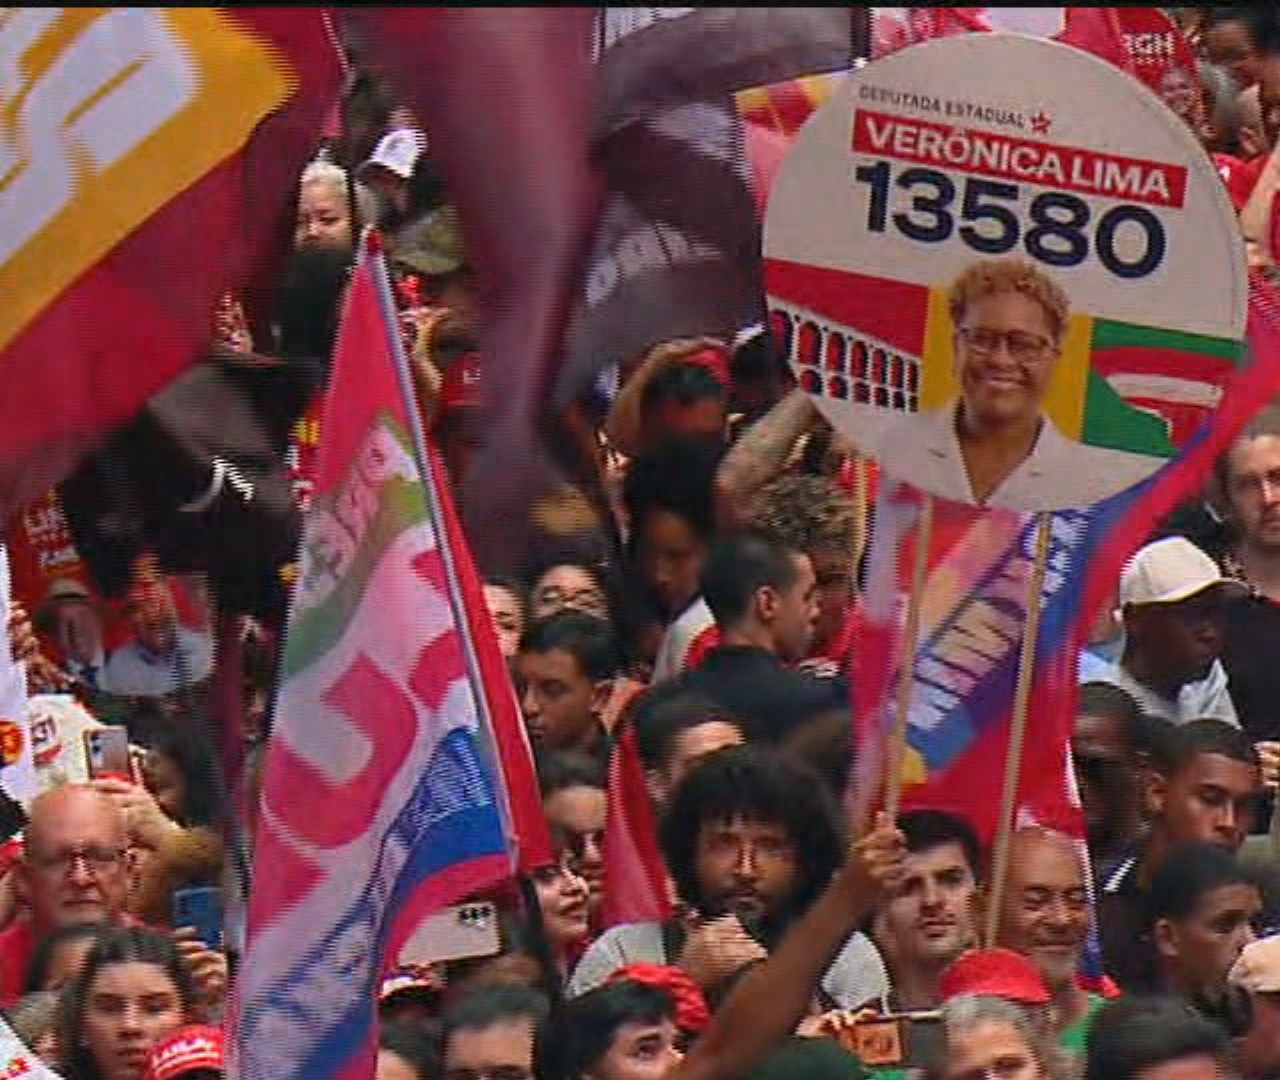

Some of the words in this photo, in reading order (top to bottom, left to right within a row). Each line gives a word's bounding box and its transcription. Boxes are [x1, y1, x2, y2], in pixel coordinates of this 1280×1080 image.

[858, 83, 941, 113] DEPUTADA
[944, 100, 1027, 129] ESTADUAL
[865, 116, 1066, 183] VERÔNICA
[1070, 156, 1171, 200] LIMA
[855, 160, 1167, 280] 13580
